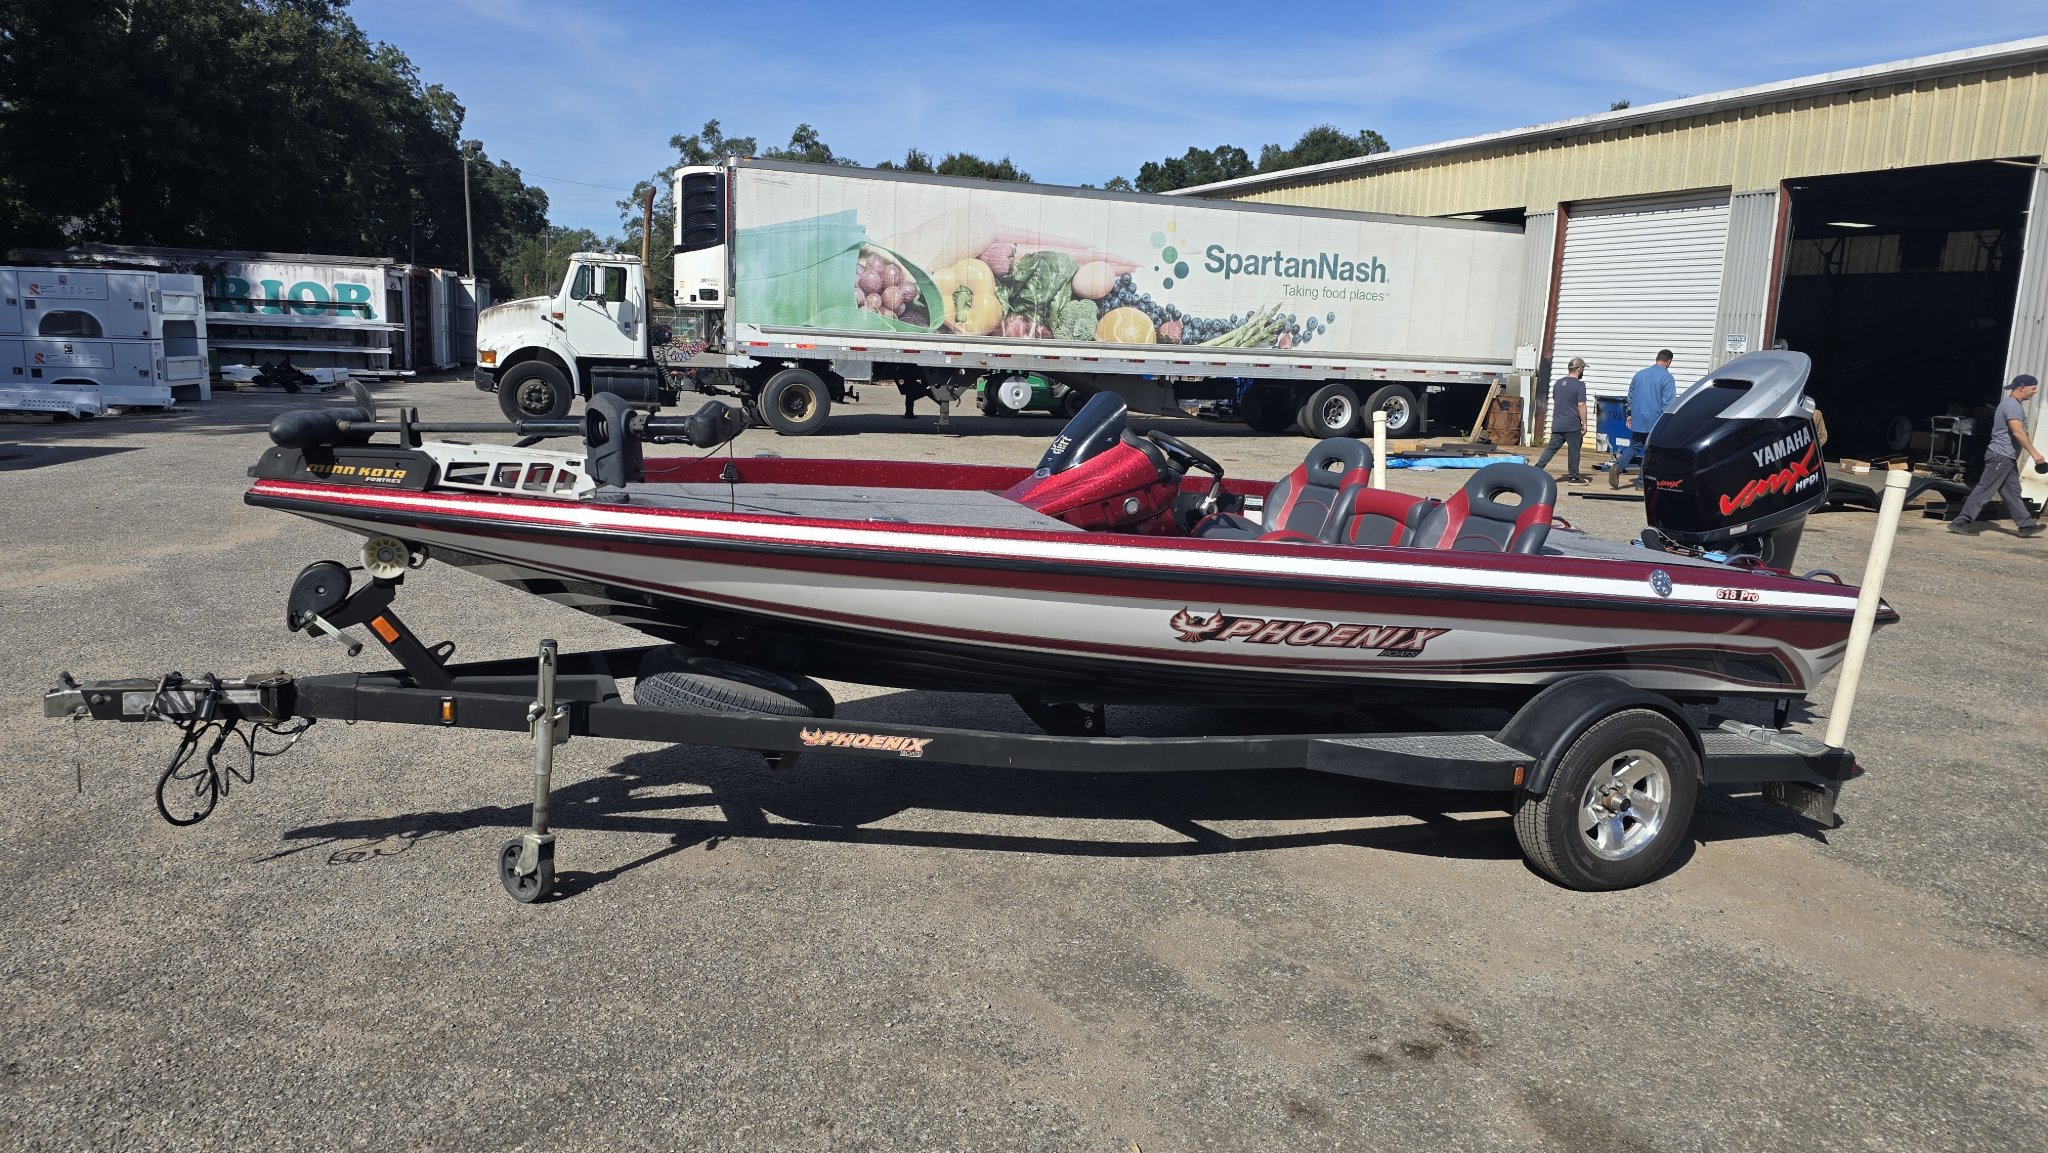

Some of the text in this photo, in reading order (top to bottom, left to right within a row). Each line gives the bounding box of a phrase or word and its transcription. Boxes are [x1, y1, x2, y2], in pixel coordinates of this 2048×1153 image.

[1204, 244, 1387, 284] SpartanNash
[1283, 284, 1385, 302] Taking food places
[1752, 426, 1811, 467] YAMAHA
[358, 466, 407, 479] KOTA
[1795, 472, 1819, 493] HPDI
[1717, 589, 1759, 602] 618 Pro
[1215, 618, 1452, 651] PHOENIX
[820, 730, 934, 752] PHOENIX
